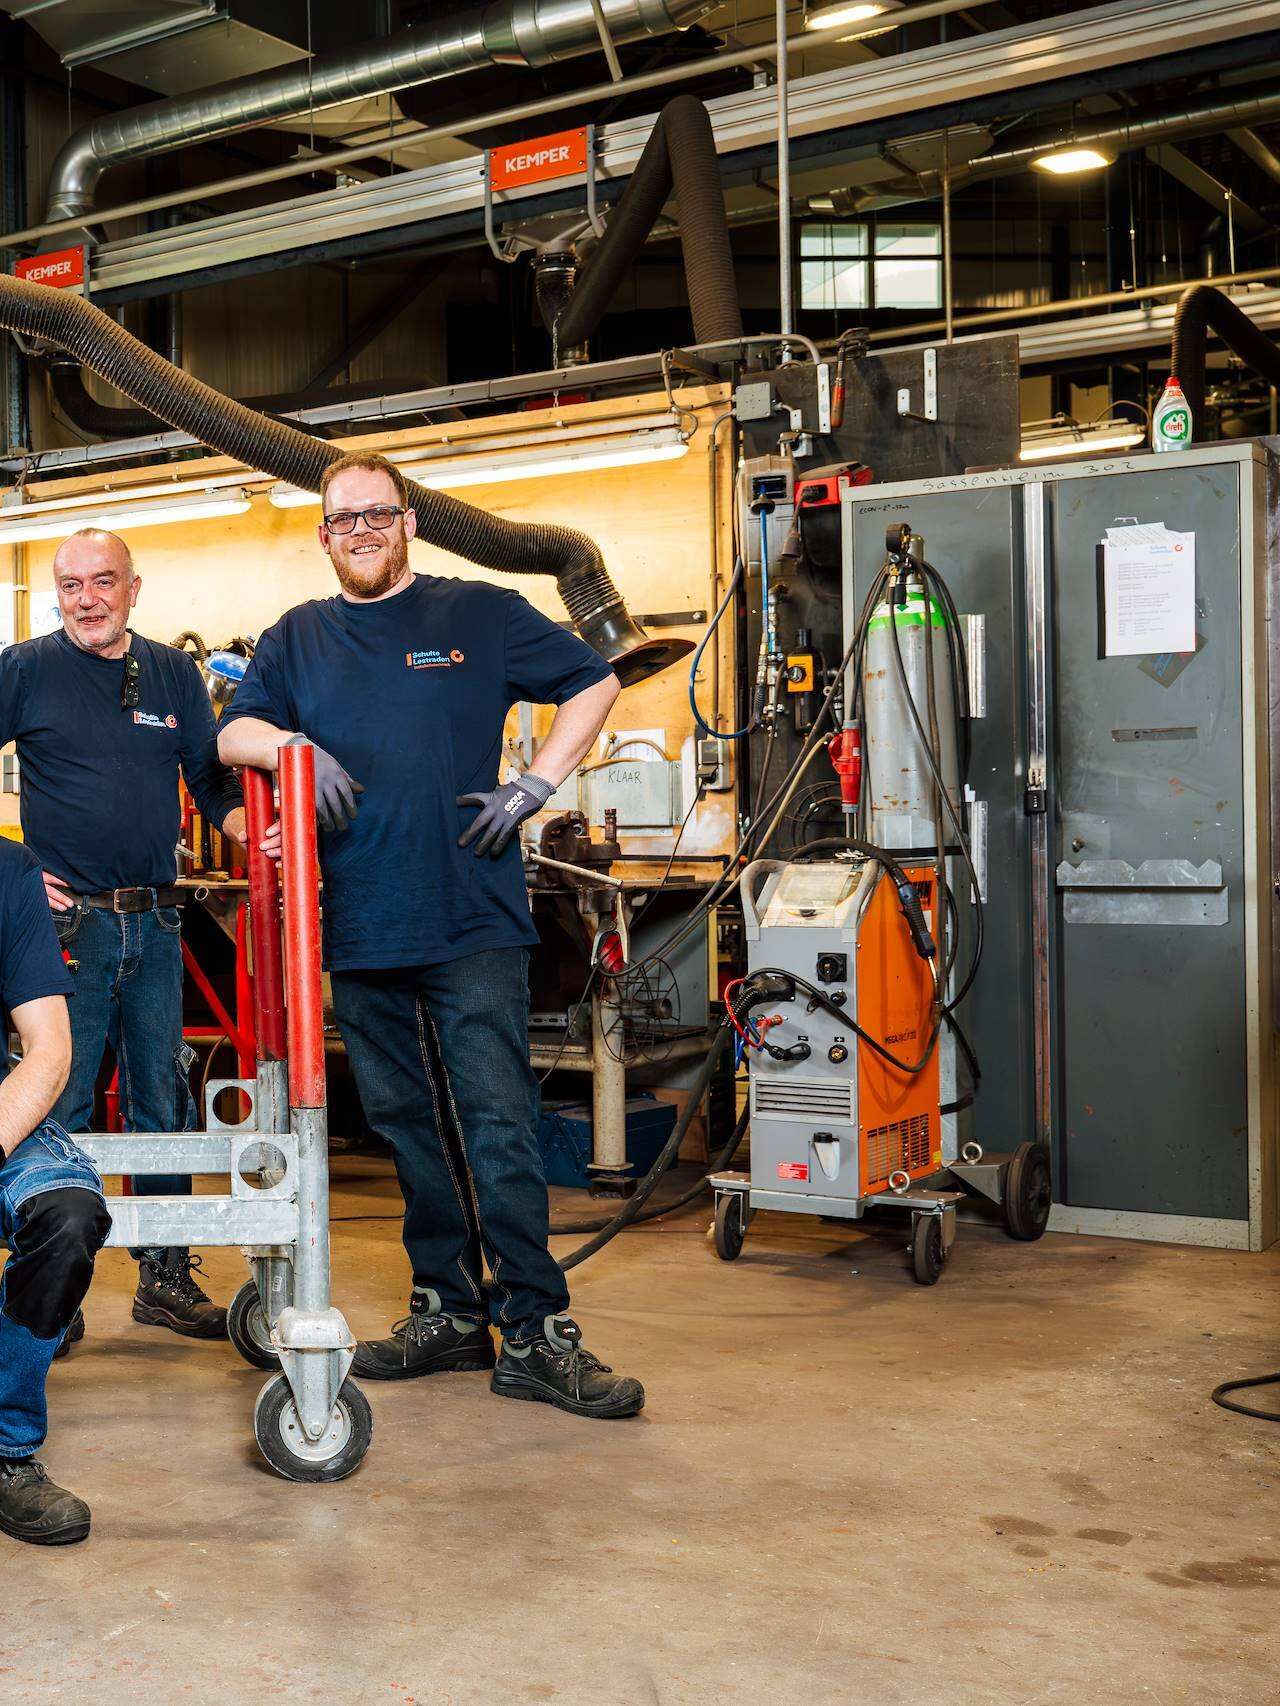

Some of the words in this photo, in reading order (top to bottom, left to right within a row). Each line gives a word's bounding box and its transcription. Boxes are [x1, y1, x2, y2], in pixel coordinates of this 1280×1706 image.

[505, 145, 570, 173] KEMPER
[25, 261, 72, 280] KEMPER
[1165, 422, 1183, 431] dreft
[413, 657, 451, 665] Lestraden
[608, 768, 643, 784] KLAAR
